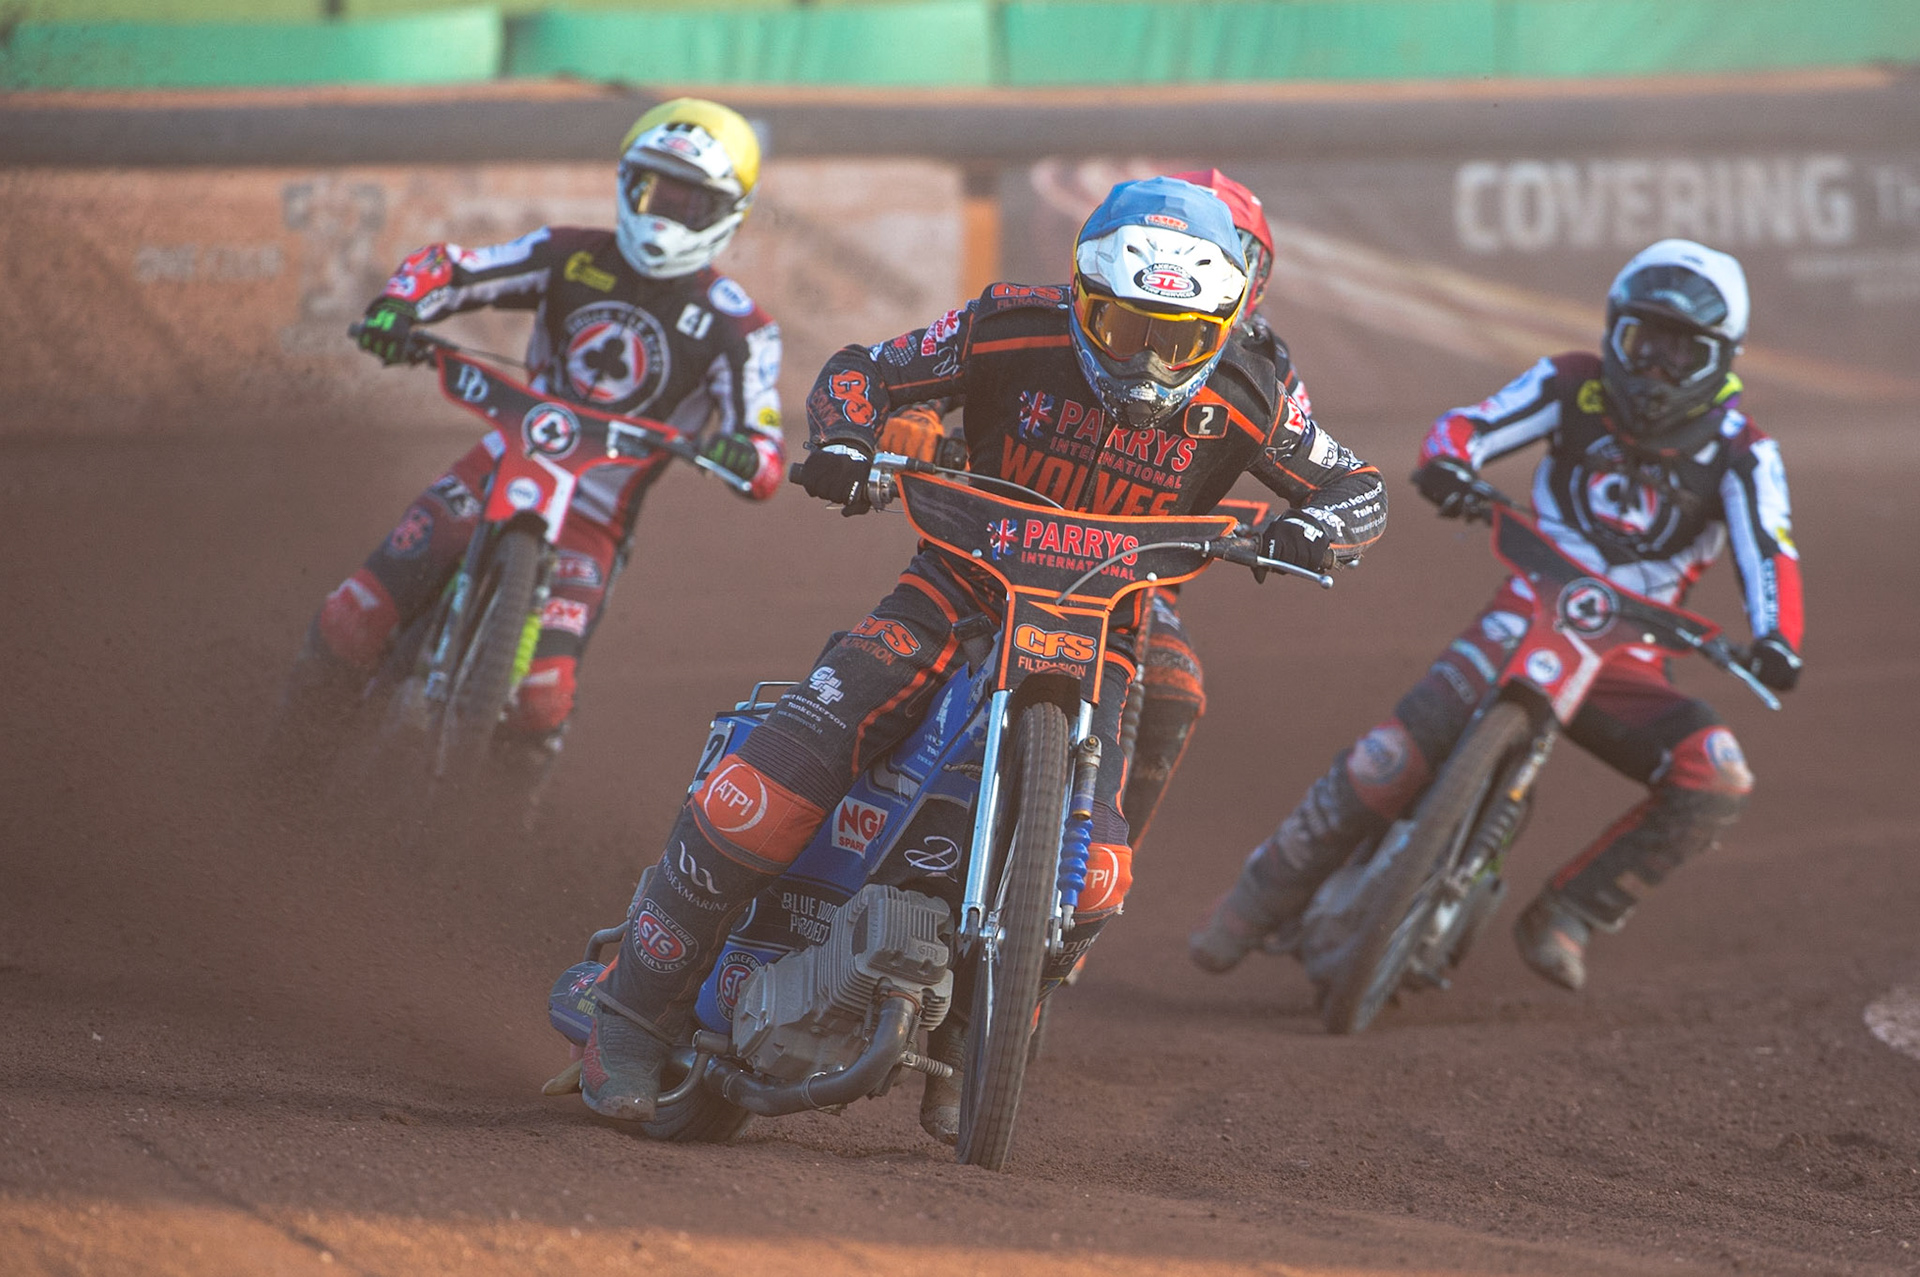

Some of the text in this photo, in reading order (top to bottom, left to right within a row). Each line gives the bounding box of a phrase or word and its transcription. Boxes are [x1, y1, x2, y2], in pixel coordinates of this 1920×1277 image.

[1454, 154, 1854, 254] COVERING
[1146, 273, 1189, 288] STS
[1056, 399, 1198, 472] PARRYS
[1198, 406, 1215, 435] 2
[1023, 519, 1139, 566] PARRYS
[1021, 551, 1136, 581] INTERNATONAL
[1014, 623, 1097, 662] CFS
[695, 733, 726, 781] 2
[714, 779, 754, 817] ATPI
[646, 901, 694, 947] STAKEFORD
[781, 892, 838, 923] BLUE DOO
[640, 921, 675, 957] STS
[789, 913, 830, 943] PROJECT
[723, 969, 746, 1000] ST
